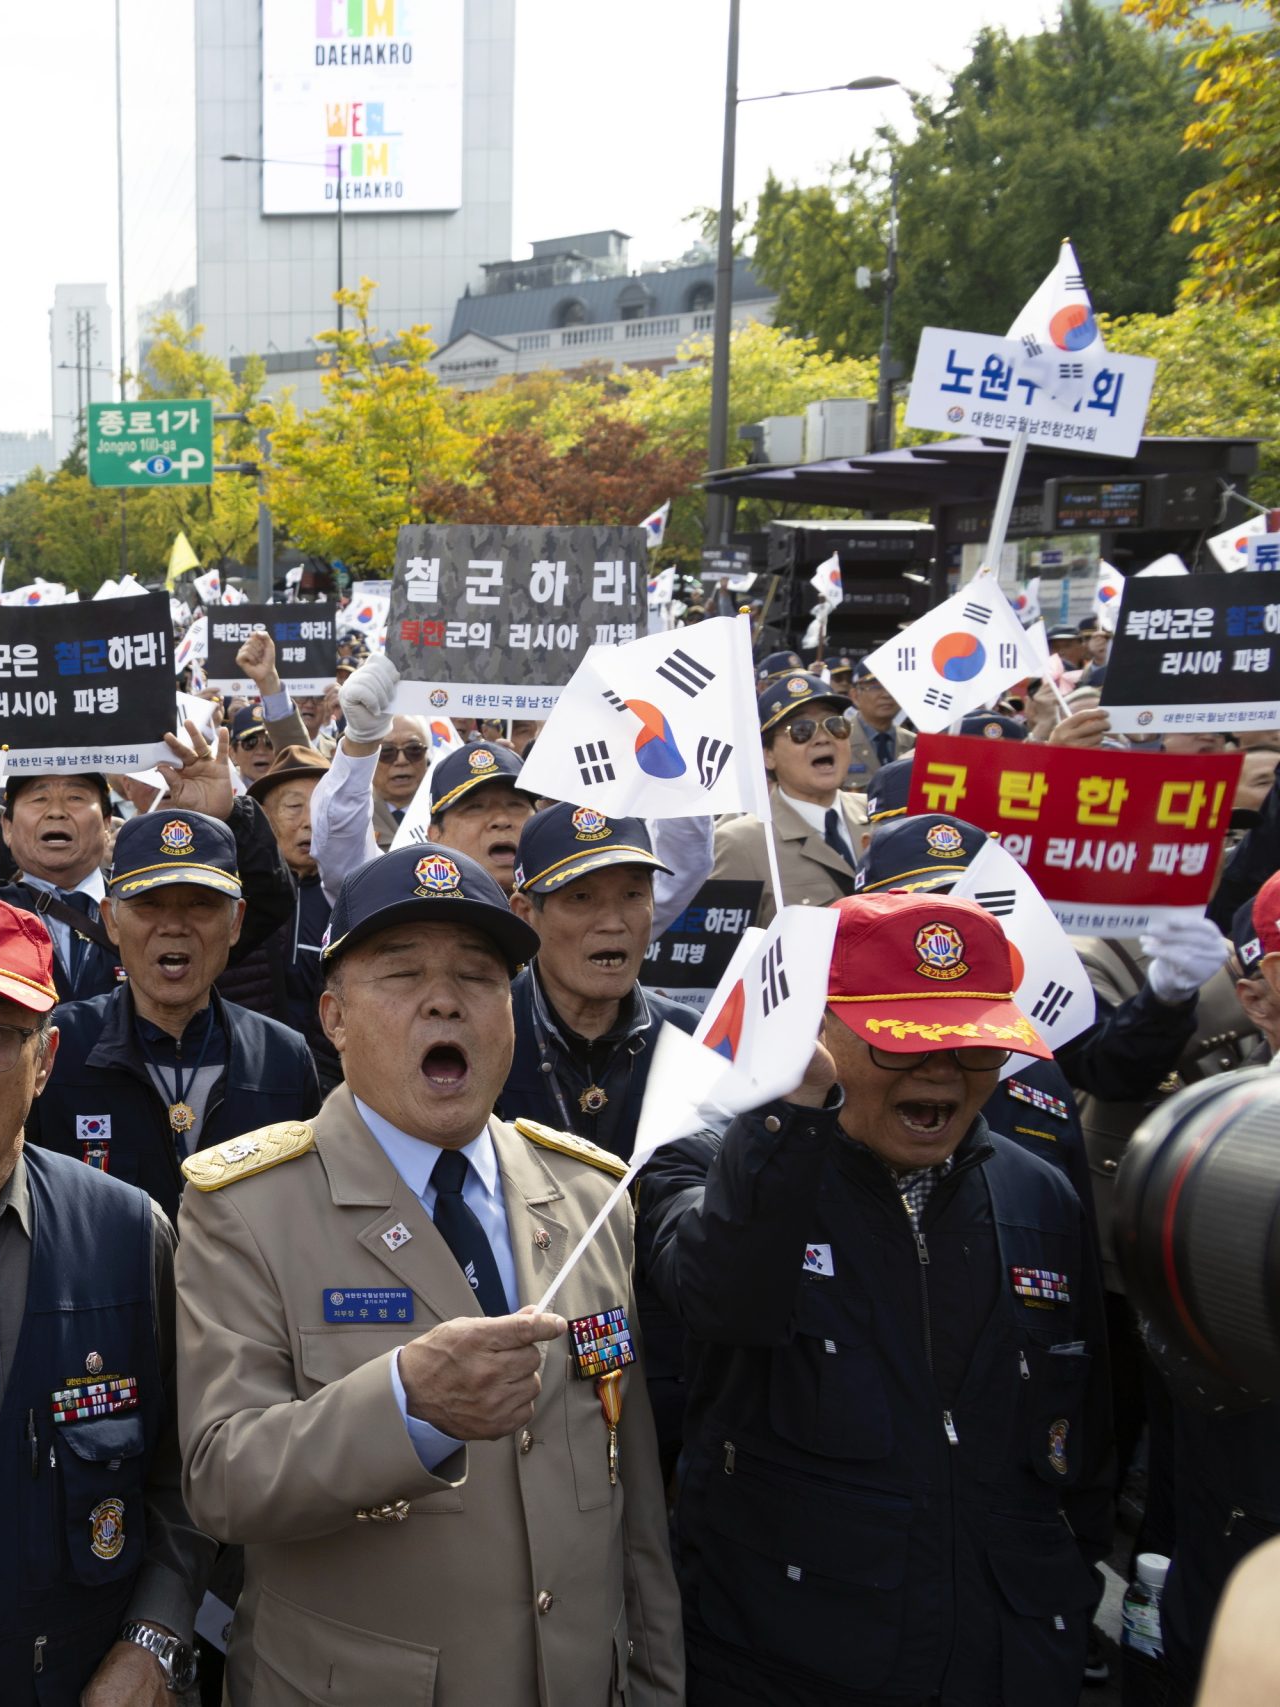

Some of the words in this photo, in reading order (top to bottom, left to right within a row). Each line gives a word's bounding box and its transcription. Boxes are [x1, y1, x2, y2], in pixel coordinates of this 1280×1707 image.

[315, 43, 413, 66] DAEHAKRO
[97, 408, 201, 436] 종로1가
[971, 411, 1097, 442] 대한민국월남전참전자회
[97, 438, 137, 456] Jongno
[153, 459, 165, 473] 6
[400, 620, 492, 649] 북한군의
[508, 622, 579, 650] 러시아
[595, 622, 638, 647] 파병
[1124, 607, 1215, 641] 북한군은
[54, 632, 167, 676] 철군하라!
[282, 647, 307, 663] 파병
[1160, 650, 1222, 676] 러시아
[1232, 647, 1271, 673] 파병
[74, 686, 119, 714] 파병
[7, 753, 140, 768] 대한민국월남전참전자회
[1044, 837, 1138, 874] 러시아
[1148, 842, 1210, 876] 파병
[670, 943, 706, 965] 파병
[920, 962, 968, 981] 국가유공자
